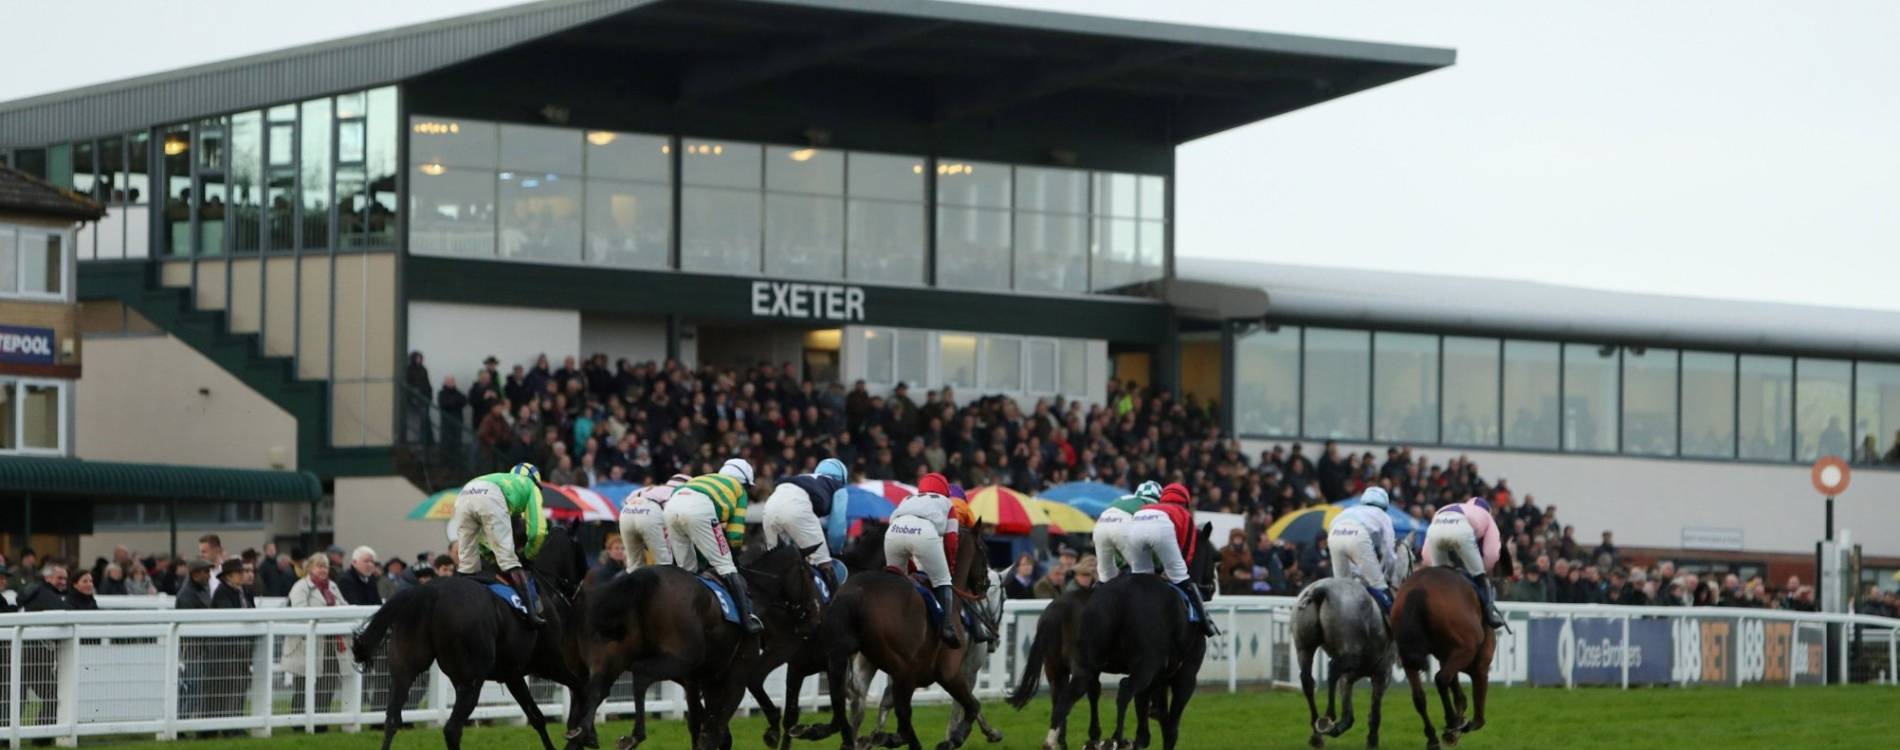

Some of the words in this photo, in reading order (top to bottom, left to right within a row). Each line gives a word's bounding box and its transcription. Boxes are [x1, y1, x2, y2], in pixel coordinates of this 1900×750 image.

[751, 281, 865, 320] EXETER
[890, 524, 922, 535] Stobart
[1576, 638, 1601, 668] Close
[1602, 637, 1642, 668] Broters
